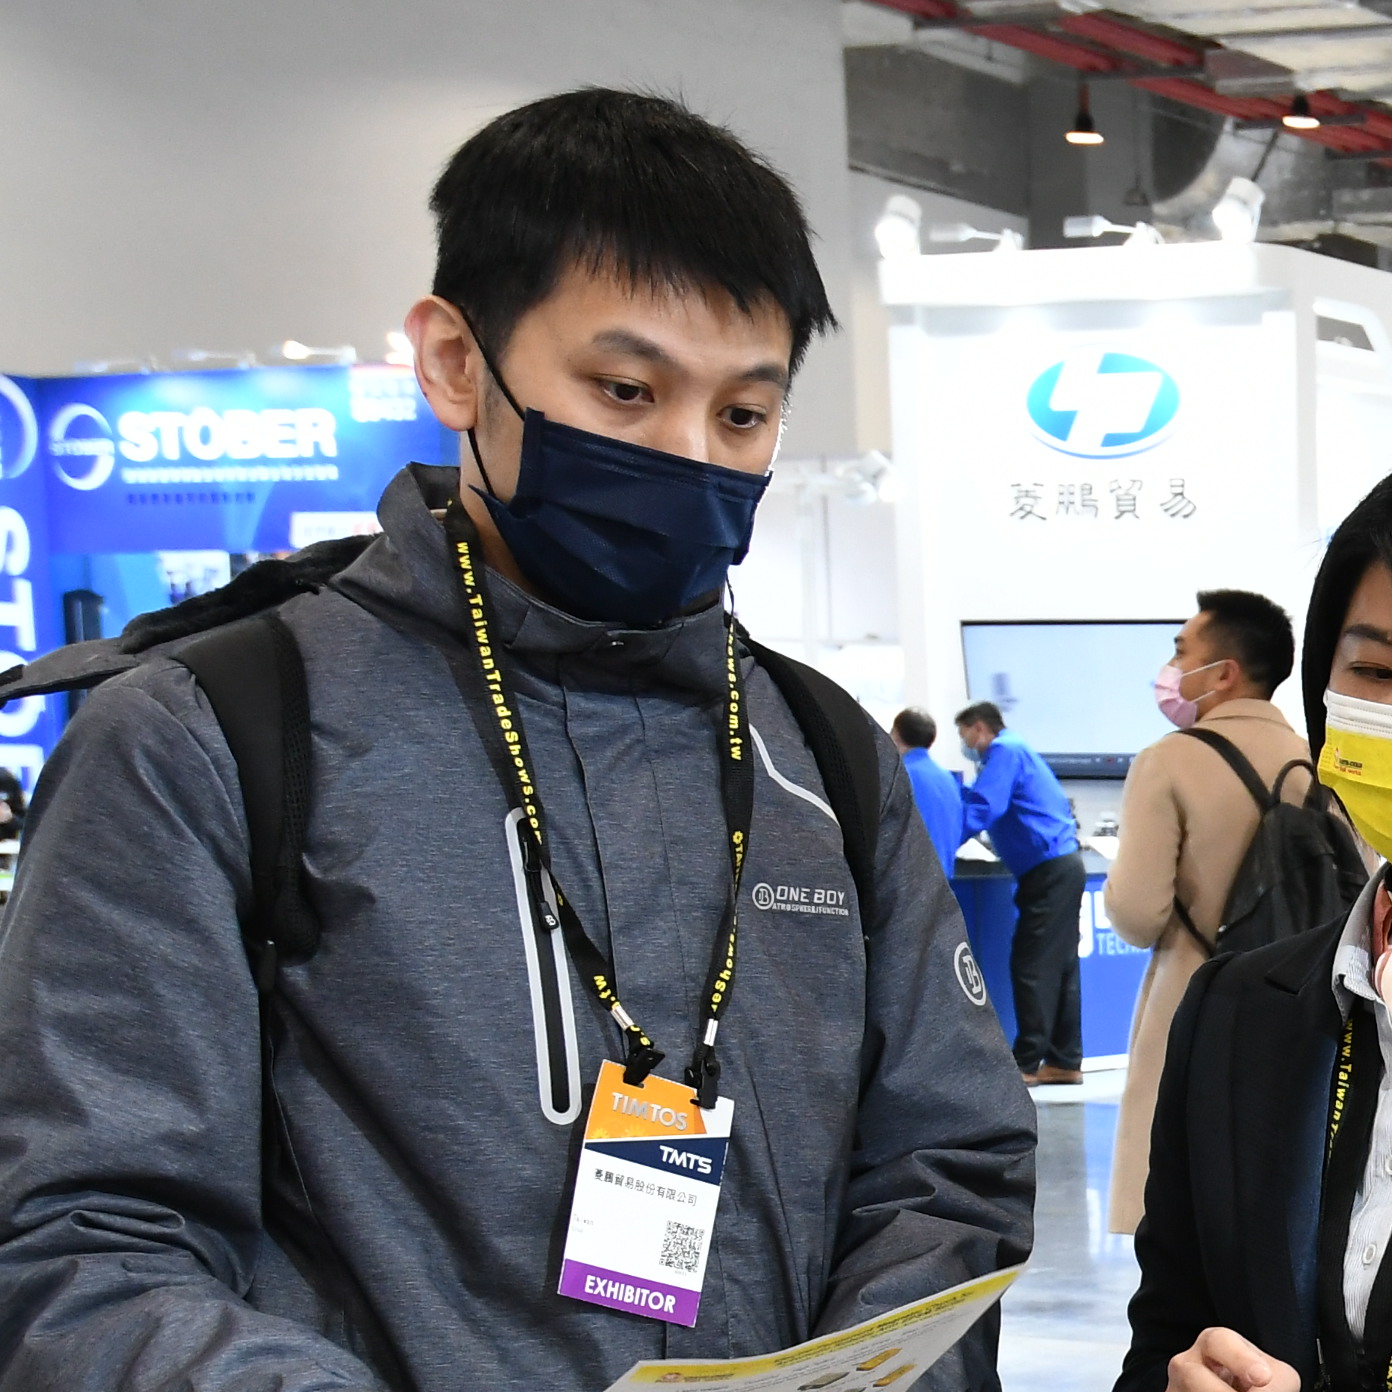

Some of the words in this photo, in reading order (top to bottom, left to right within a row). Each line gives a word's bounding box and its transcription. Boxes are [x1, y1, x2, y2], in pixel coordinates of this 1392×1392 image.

[776, 885, 811, 903] ONE
[813, 888, 846, 906] BOY
[612, 1092, 689, 1131] TIMTOS
[659, 1144, 713, 1175] TMTS
[584, 1274, 677, 1314] EXHIBITOR
